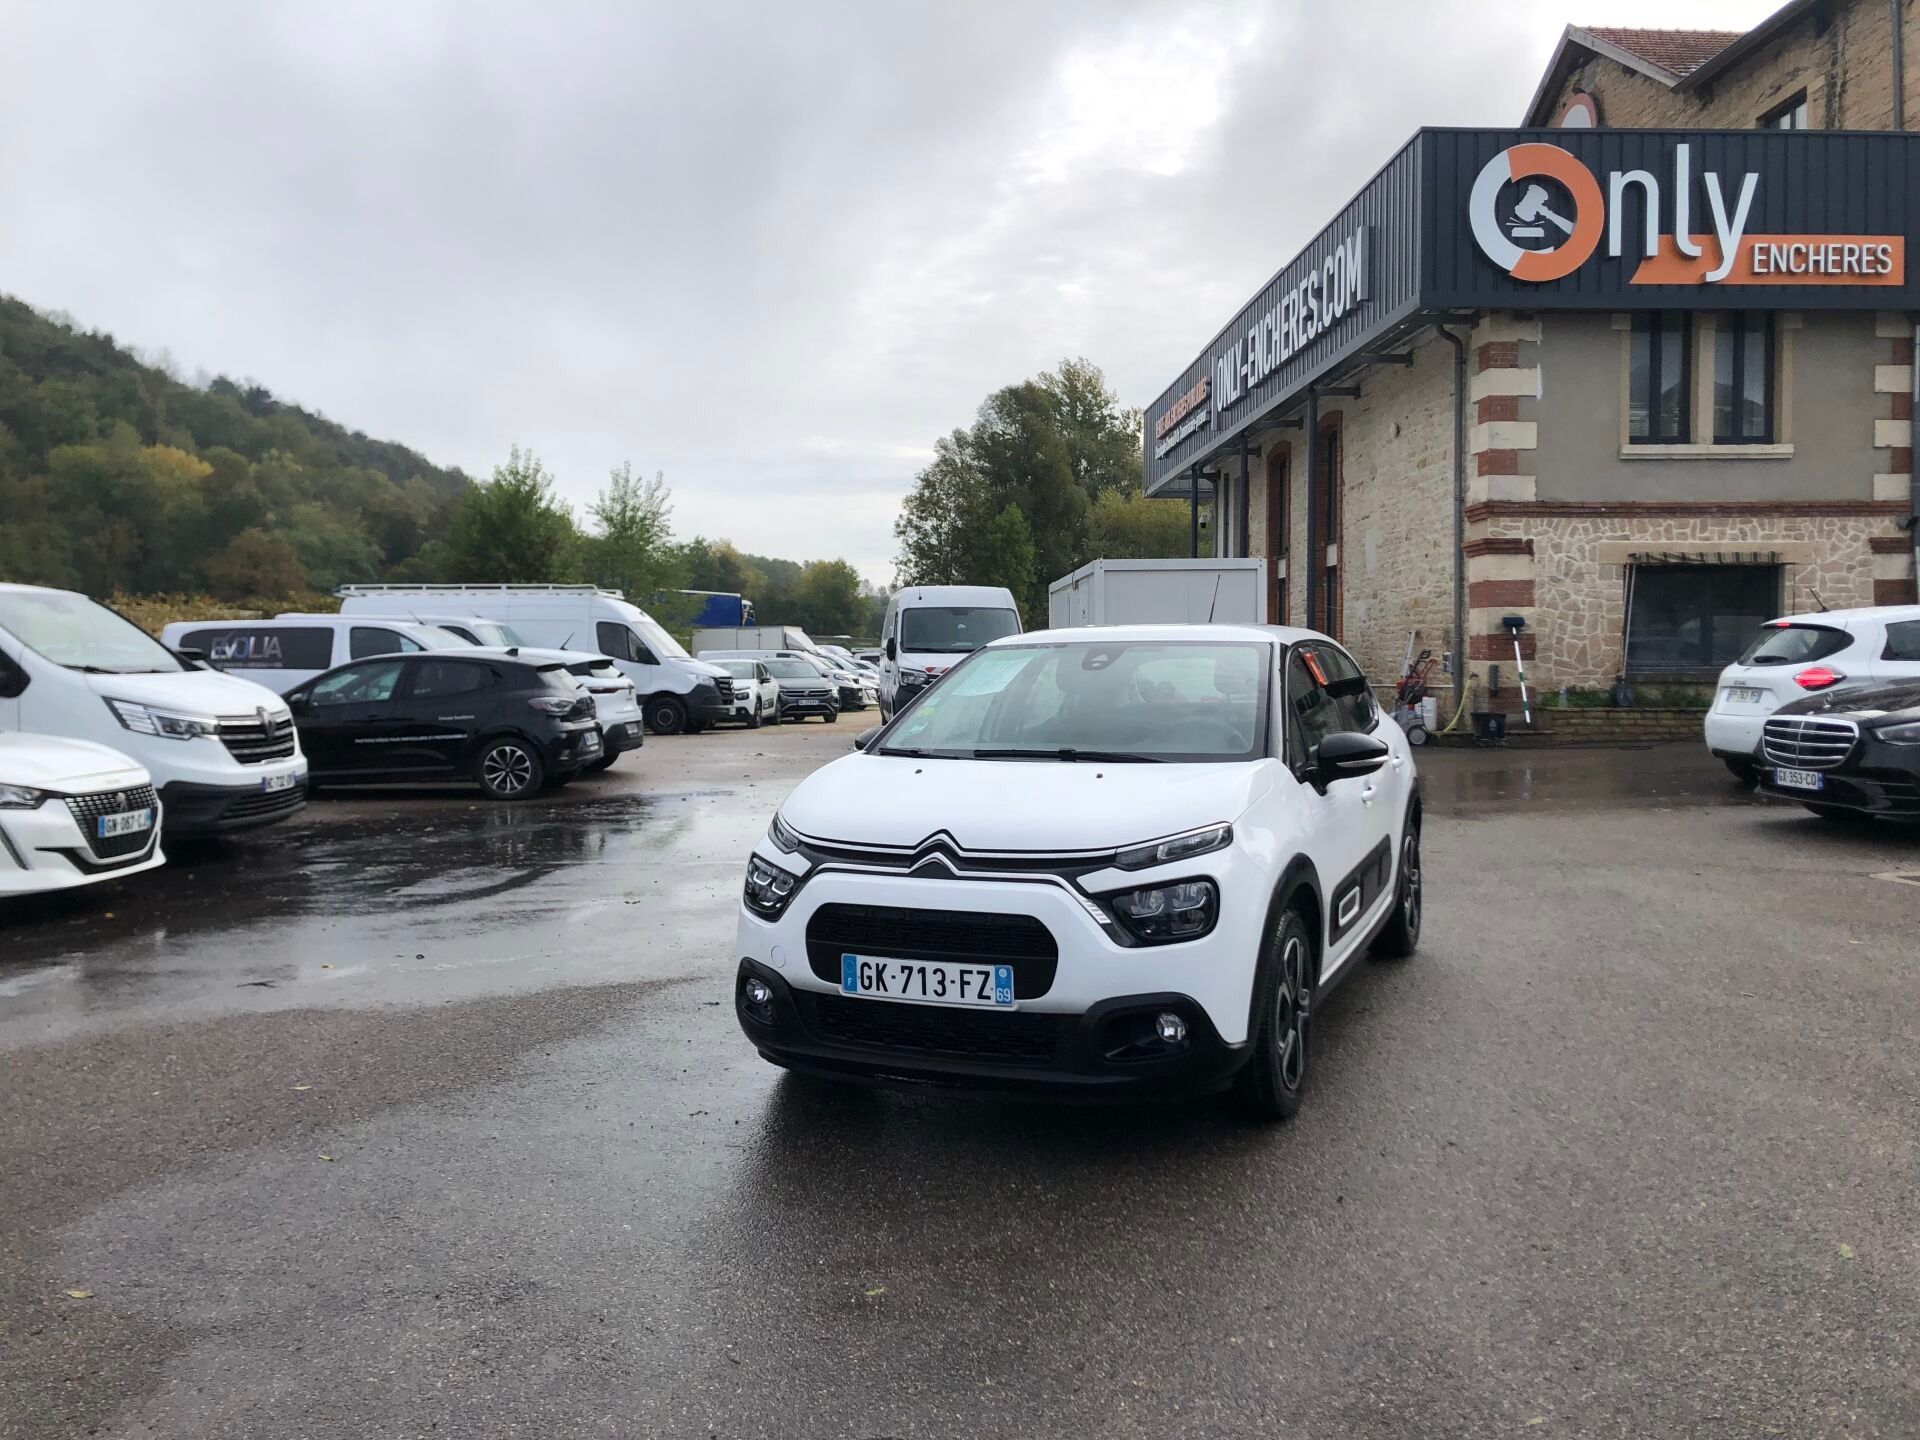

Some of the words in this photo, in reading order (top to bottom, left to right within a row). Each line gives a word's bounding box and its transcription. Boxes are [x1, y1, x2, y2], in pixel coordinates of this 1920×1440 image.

[1753, 243, 1893, 274] ENCHERES
[1216, 226, 1365, 413] ONLY-ENCHERES.COM
[859, 961, 992, 1001] GK-713-FZ
[996, 987, 1011, 1003] 69
